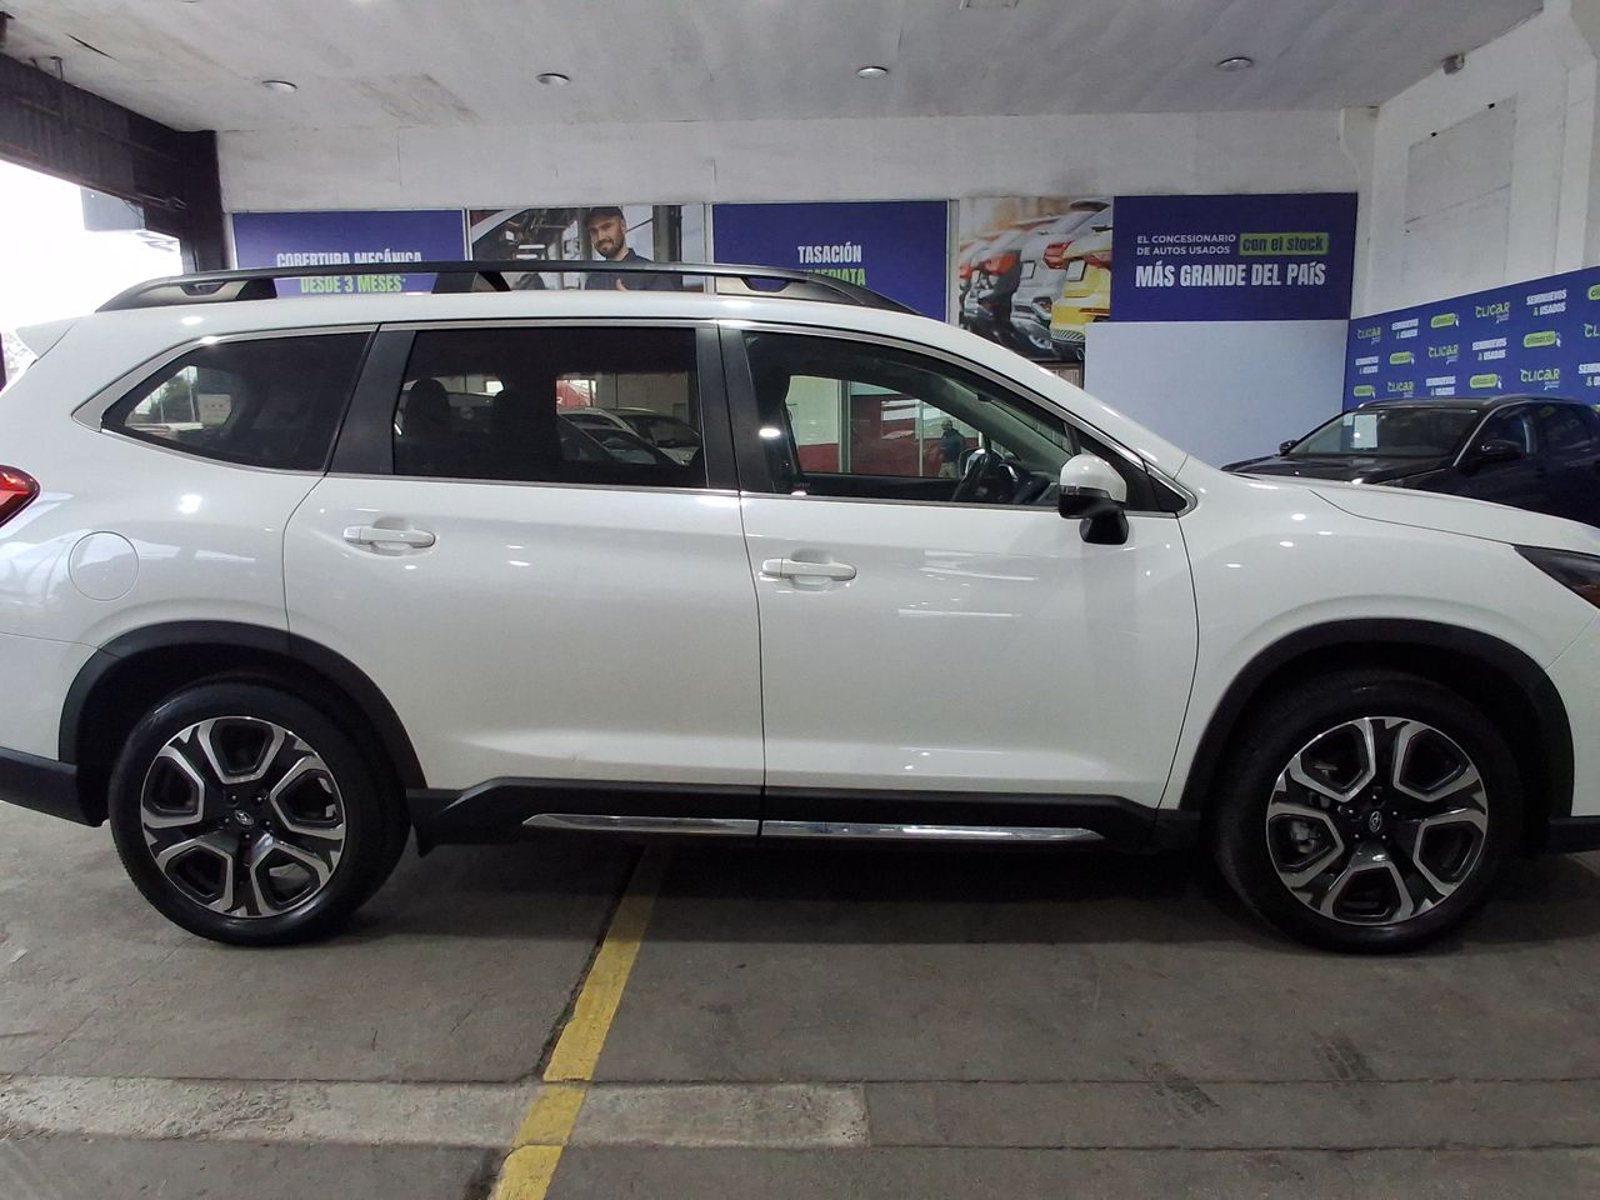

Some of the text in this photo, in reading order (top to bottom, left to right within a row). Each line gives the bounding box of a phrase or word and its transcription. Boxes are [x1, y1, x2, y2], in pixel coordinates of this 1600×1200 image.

[1137, 234, 1236, 244] EL CONCESIONARIO
[1243, 236, 1324, 251] con el stock
[797, 241, 862, 263] TASACIÓN
[1137, 245, 1230, 256] DE AUTOS USADOS
[1136, 261, 1326, 287] MÁS GRANDE DEL PAÍS
[300, 275, 341, 293] DESDE
[344, 275, 353, 293] 3
